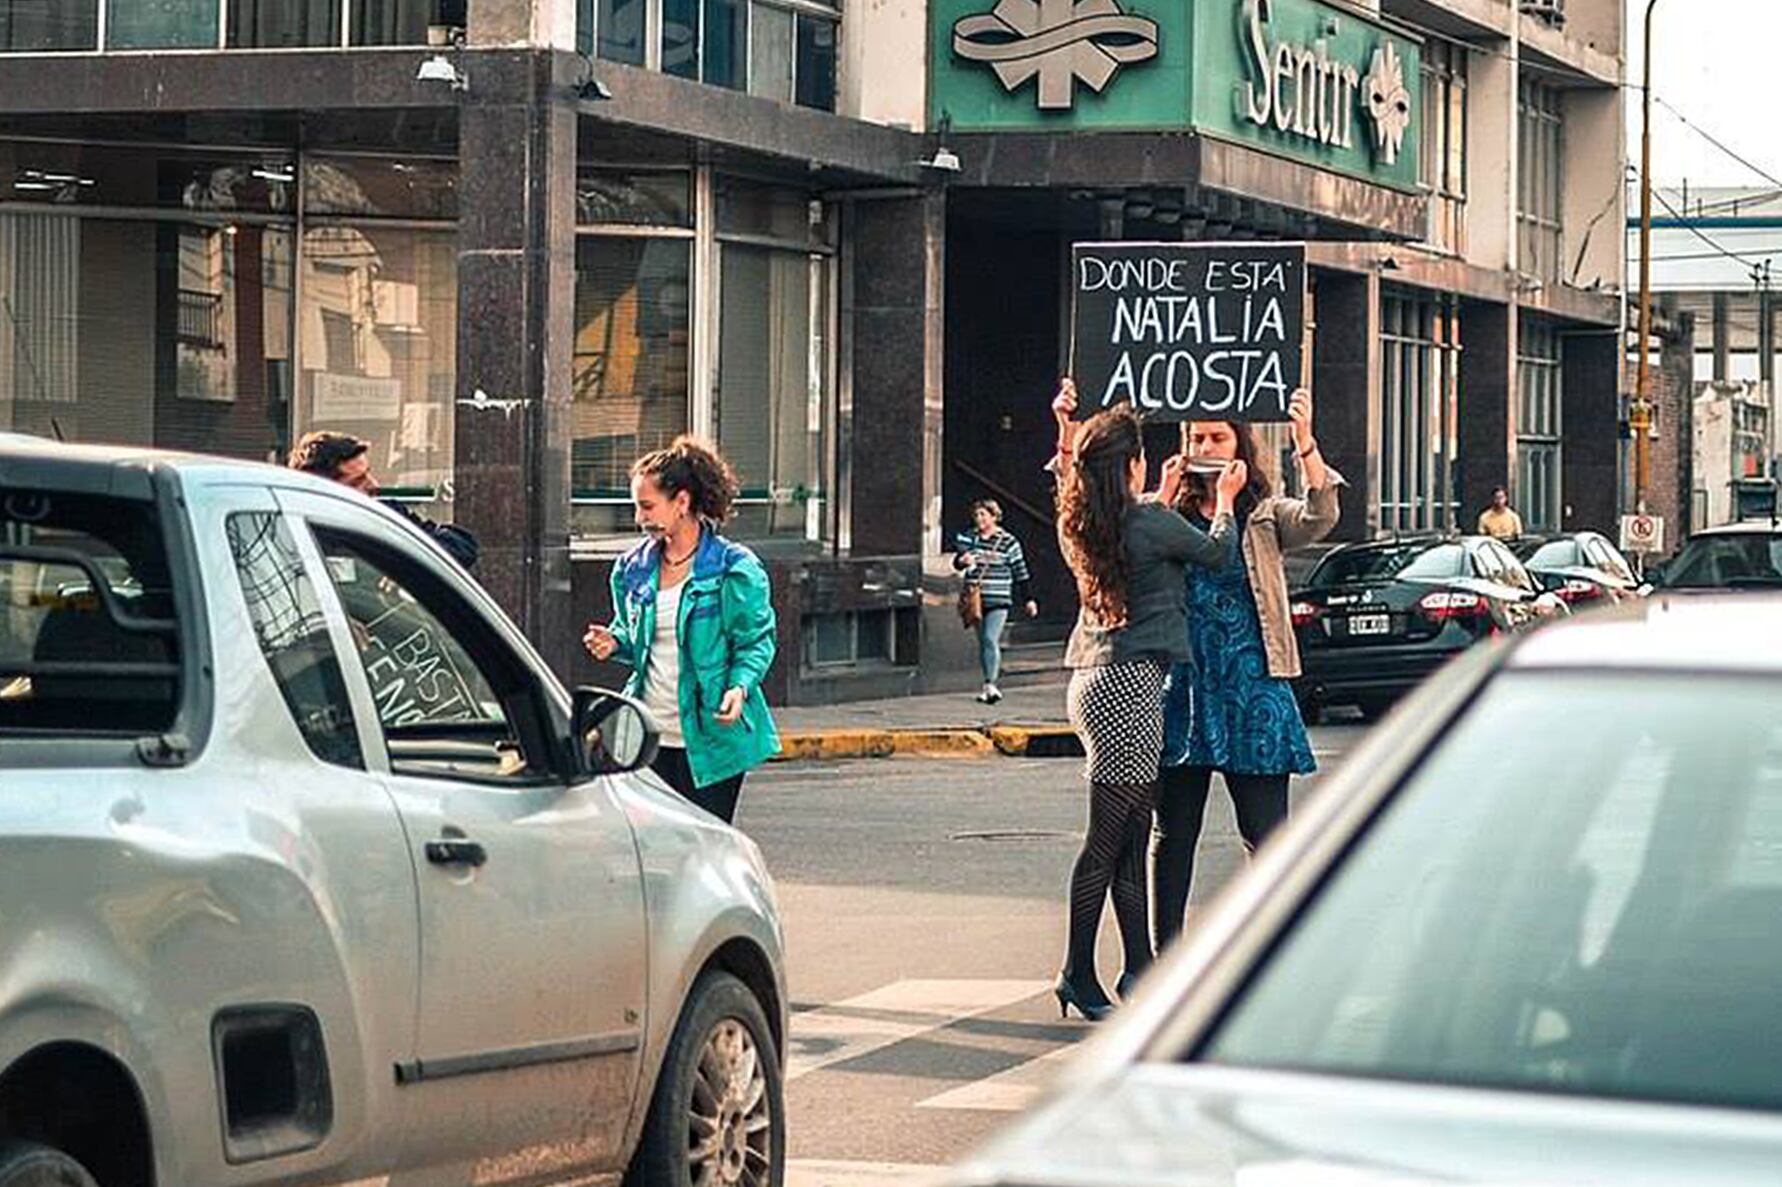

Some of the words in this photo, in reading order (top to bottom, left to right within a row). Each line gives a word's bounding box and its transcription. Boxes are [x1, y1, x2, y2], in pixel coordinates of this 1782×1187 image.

[1240, 0, 1358, 149] Sentir
[1080, 257, 1187, 291] DONDE
[1102, 350, 1288, 412] ACOSTA
